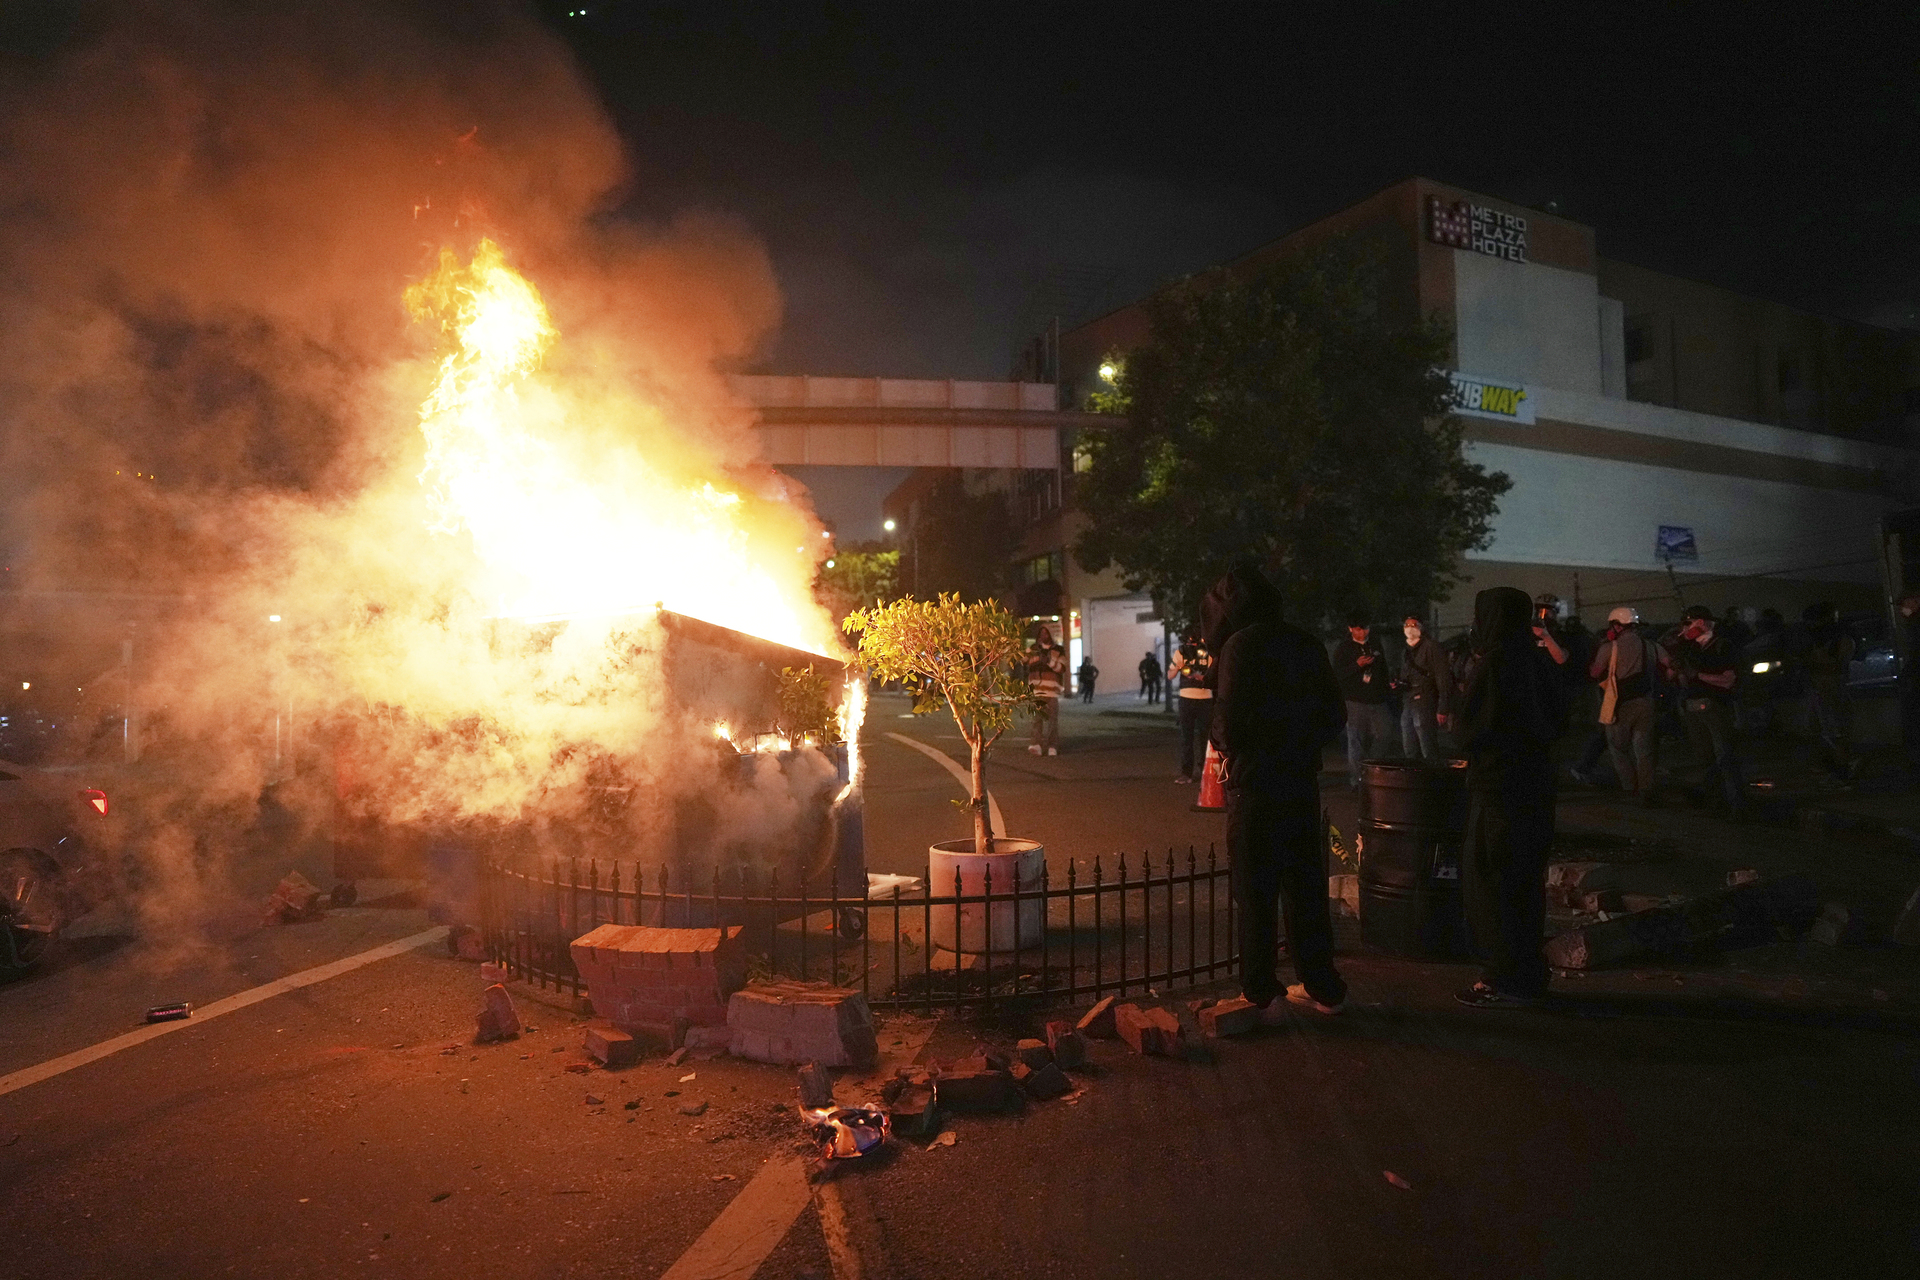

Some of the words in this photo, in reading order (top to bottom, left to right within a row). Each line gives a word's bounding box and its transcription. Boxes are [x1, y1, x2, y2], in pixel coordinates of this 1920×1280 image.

[1469, 203, 1527, 232] METRO
[1471, 219, 1527, 247] PLAZA
[1472, 235, 1530, 264] HOTEL
[1450, 379, 1527, 415] UBWAY
